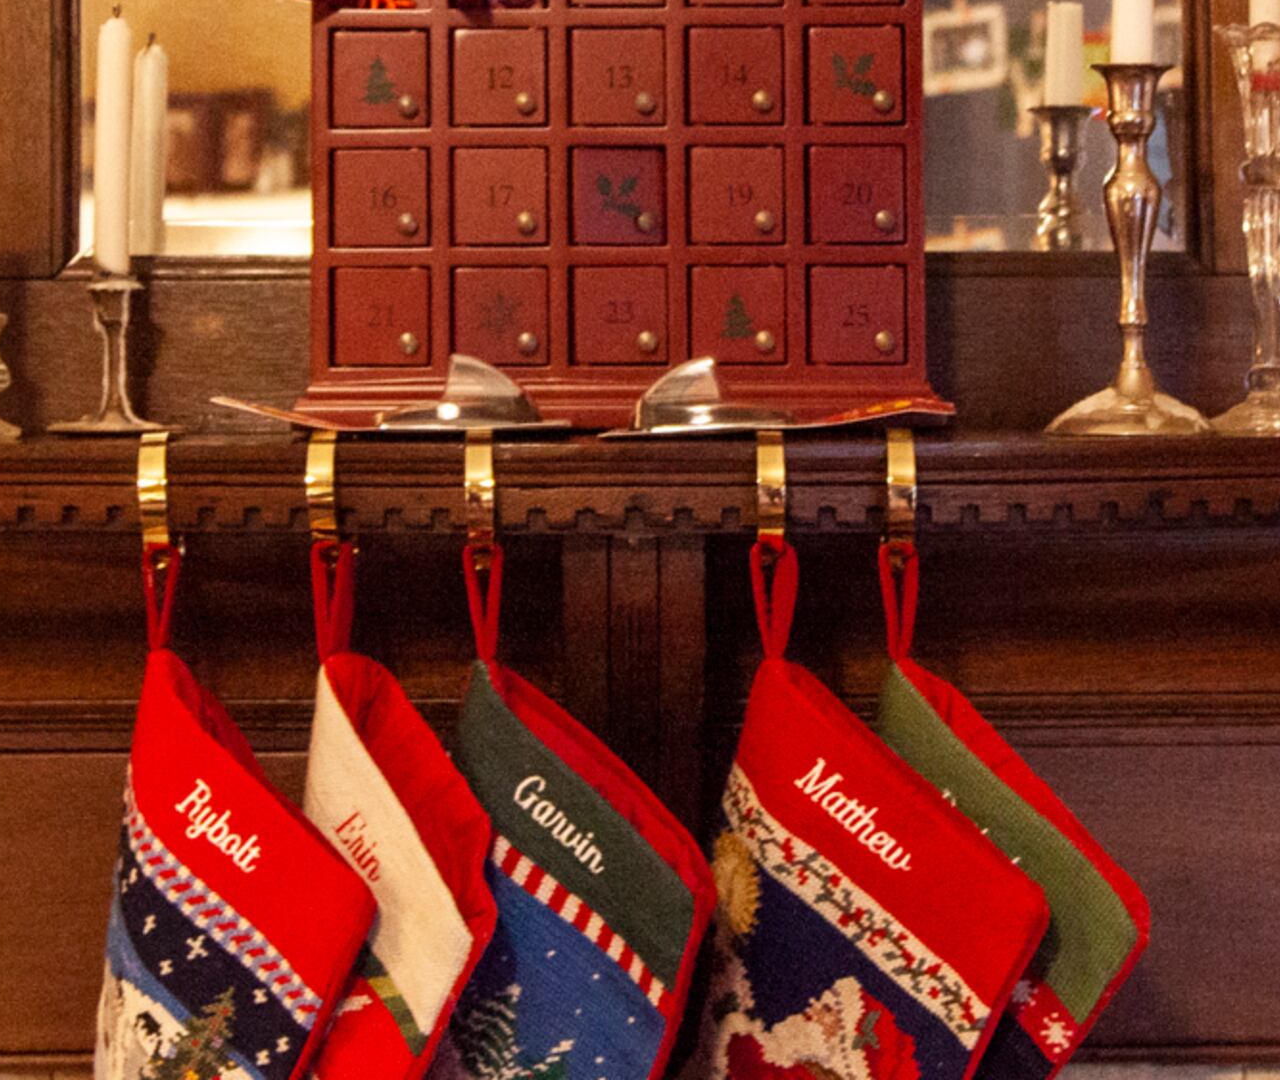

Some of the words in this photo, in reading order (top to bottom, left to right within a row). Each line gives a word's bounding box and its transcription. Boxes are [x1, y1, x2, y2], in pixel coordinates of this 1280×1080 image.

[487, 64, 515, 90] 12
[607, 64, 634, 89] 13
[723, 64, 748, 86] 14
[370, 185, 397, 210] 16
[487, 184, 515, 207] 17
[727, 184, 753, 207] 19
[842, 182, 873, 205] 20
[367, 303, 394, 328] 21
[842, 304, 870, 328] 25
[174, 778, 262, 875] Rybolt
[513, 774, 606, 876] Garwin
[793, 757, 912, 873] Matthew
[334, 810, 384, 884] Erin
